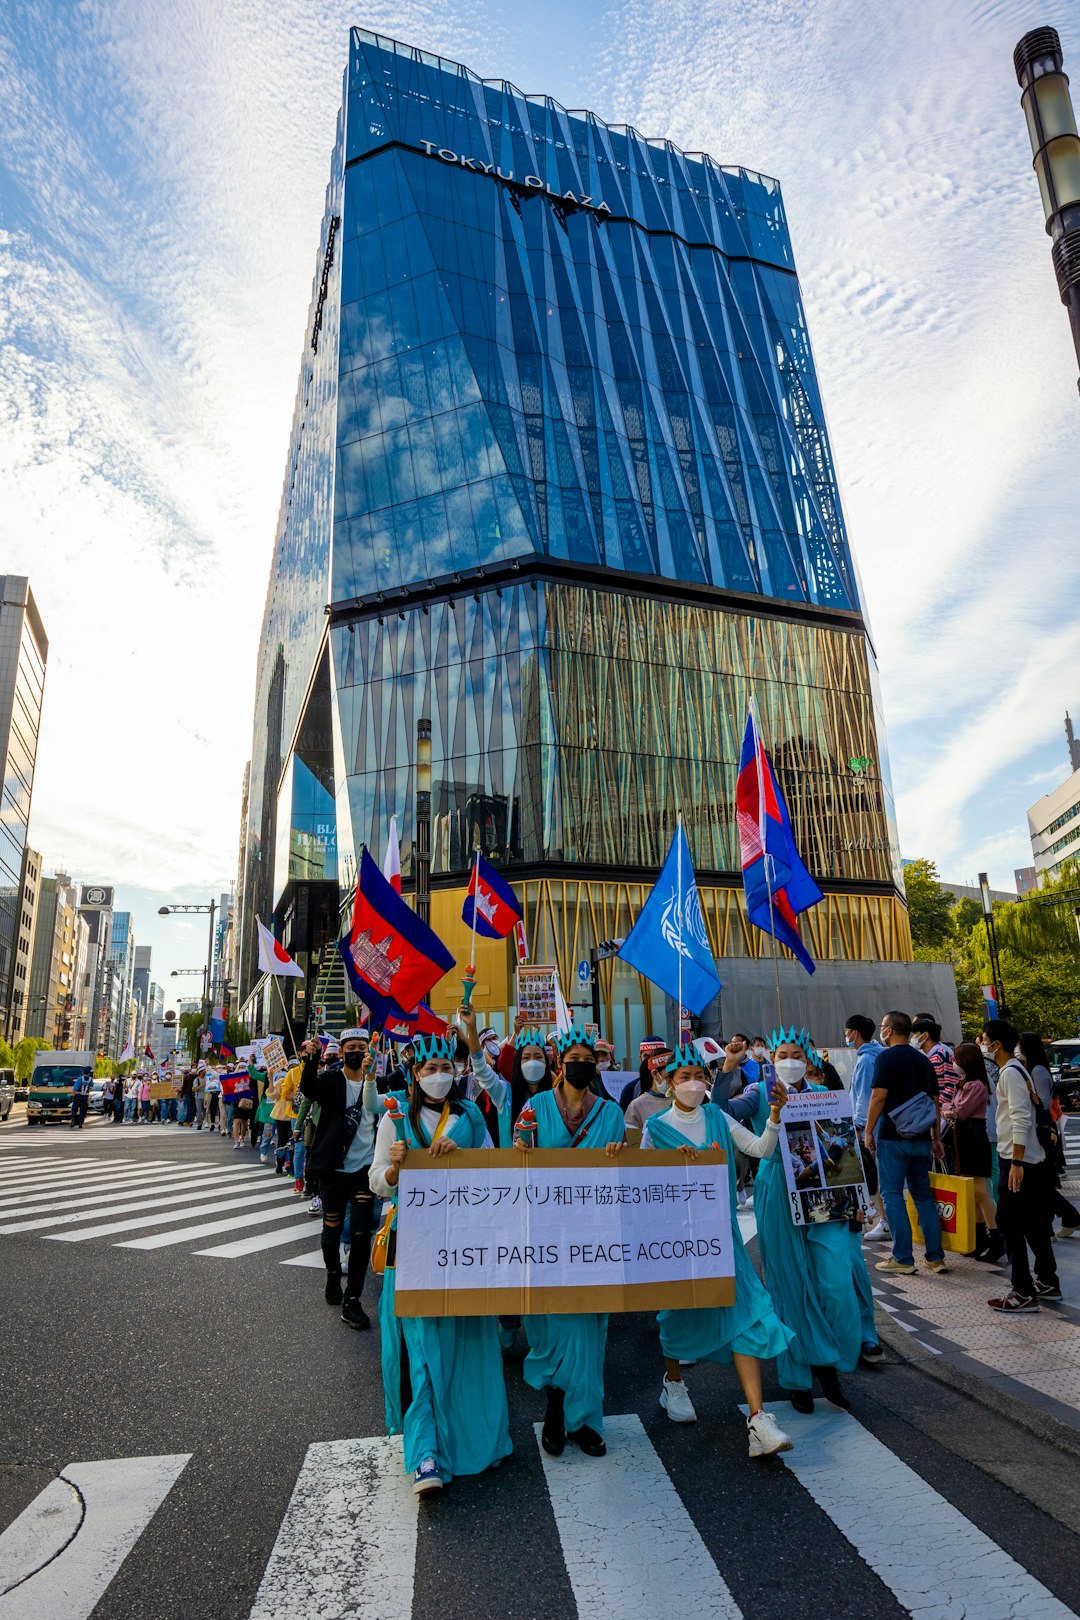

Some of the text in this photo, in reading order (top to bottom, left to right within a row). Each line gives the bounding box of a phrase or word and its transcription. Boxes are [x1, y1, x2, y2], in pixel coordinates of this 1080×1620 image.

[420, 139, 612, 214] TOKYU PLAZA
[799, 1092, 838, 1101] CAMBODIA
[406, 1181, 716, 1207] カンボジアパリ和平協定31周年デモ
[437, 1238, 722, 1267] 31ST PARIS PEACE ACCORDS
